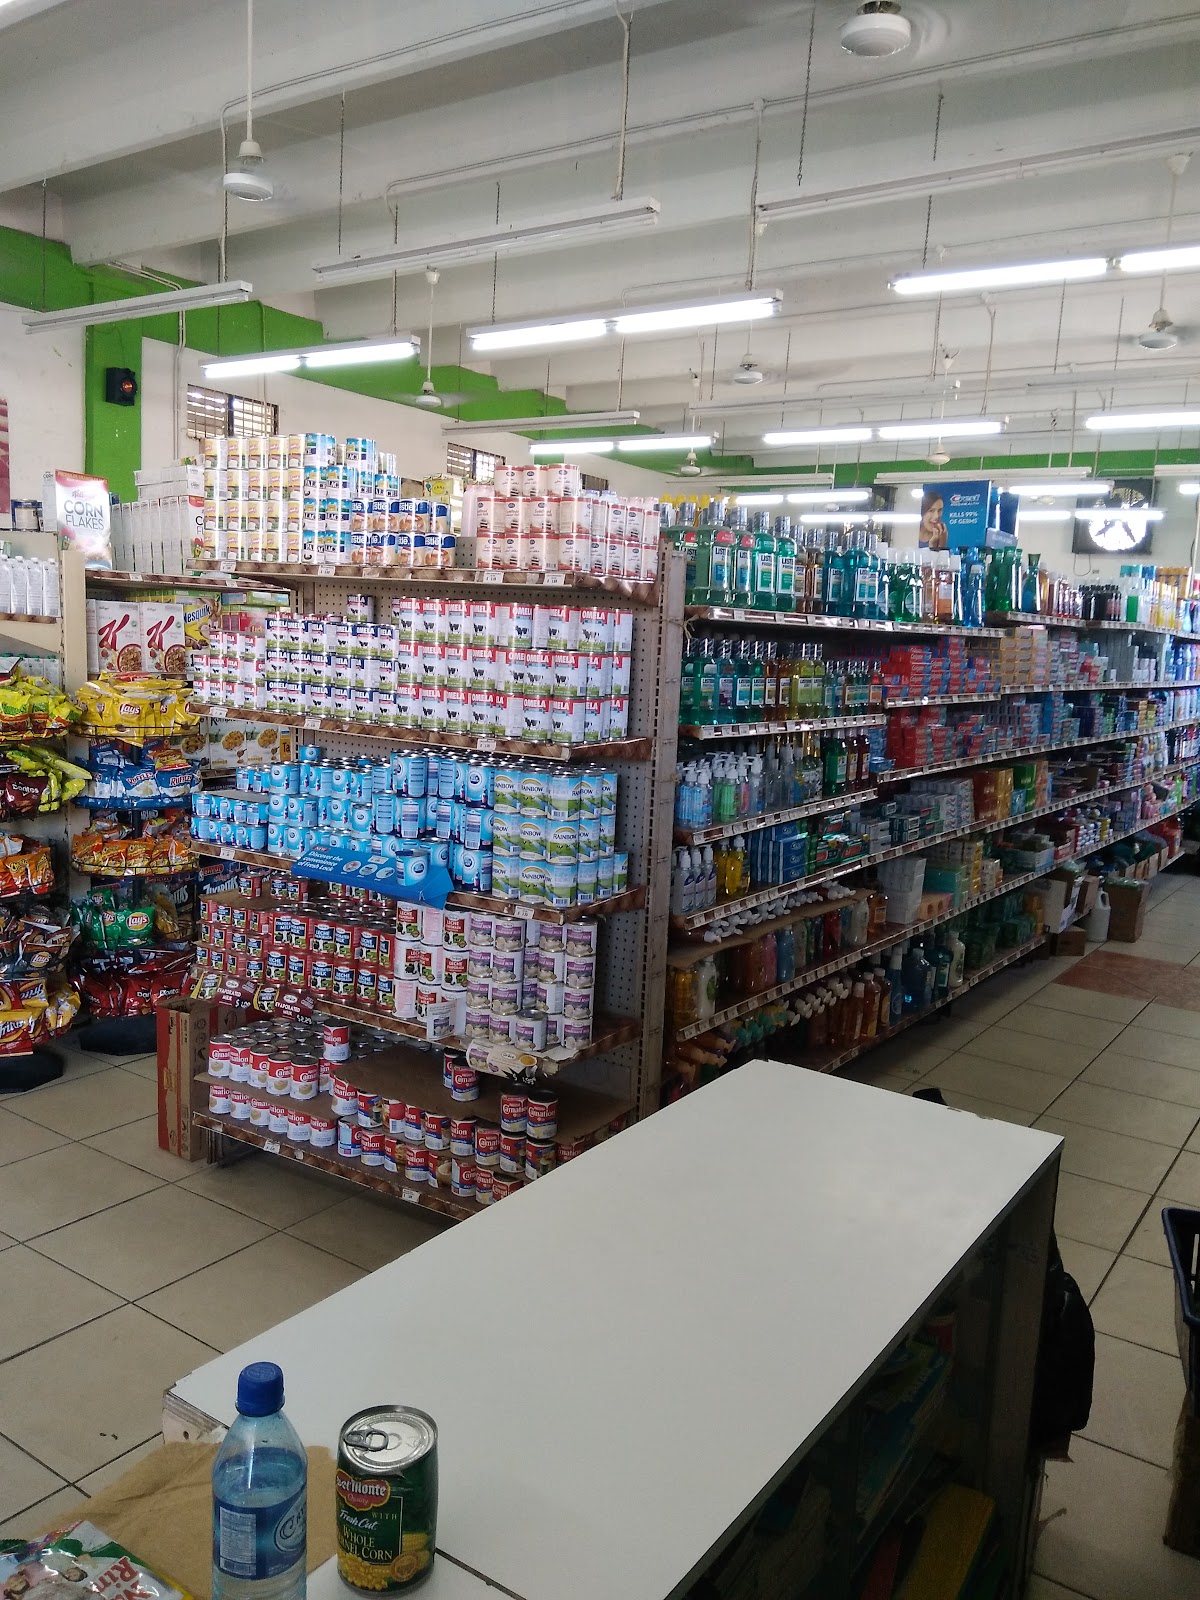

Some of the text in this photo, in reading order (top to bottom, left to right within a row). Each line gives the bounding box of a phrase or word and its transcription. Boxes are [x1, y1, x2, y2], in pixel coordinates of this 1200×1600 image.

[64, 500, 104, 517] CORN
[65, 514, 104, 530] FLAKES
[582, 610, 606, 620] OMELA
[526, 654, 549, 663] OMELA
[472, 693, 493, 703] OMELA
[523, 699, 546, 708] OMELA
[552, 833, 577, 841] RAINBOW
[308, 851, 332, 860] Discover
[303, 857, 338, 867] convenience
[521, 872, 545, 880] RAINBOW
[351, 1481, 387, 1497] Monte
[340, 1509, 359, 1526] Fresh
[371, 1512, 397, 1520] WITH
[343, 1524, 375, 1548] WHOLE
[362, 1547, 393, 1560] CORN
